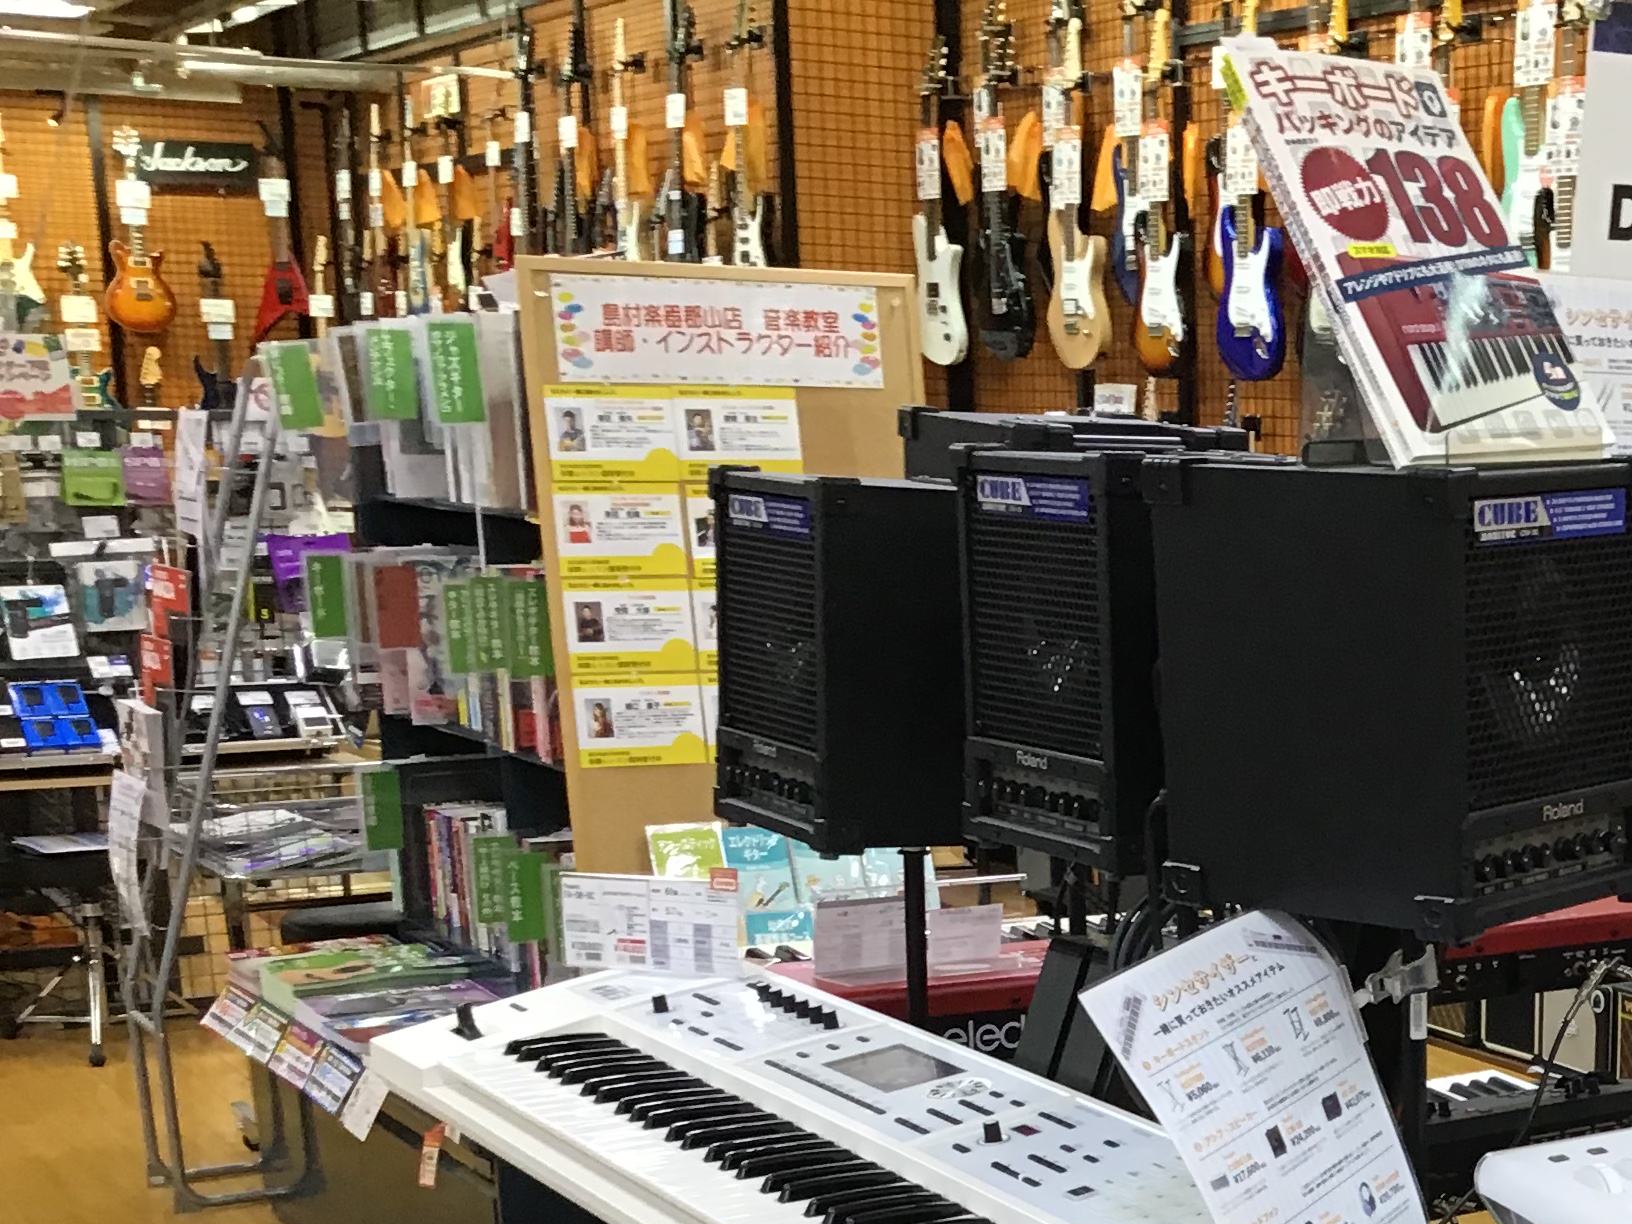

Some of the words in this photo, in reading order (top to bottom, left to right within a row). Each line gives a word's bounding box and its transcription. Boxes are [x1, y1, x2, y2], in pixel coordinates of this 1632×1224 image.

[1251, 60, 1420, 119] キーボード
[1276, 110, 1457, 149] バッキングのアイデア
[1310, 174, 1381, 216] 即戦力
[1365, 147, 1509, 248] 138
[601, 303, 743, 329] 島村楽器郡山店
[763, 308, 840, 334] 音楽教室
[594, 329, 850, 358] 講師・インストラクター紹介
[1478, 501, 1540, 527] CUBE
[1016, 749, 1048, 770] Roland
[1543, 798, 1584, 822] Roland
